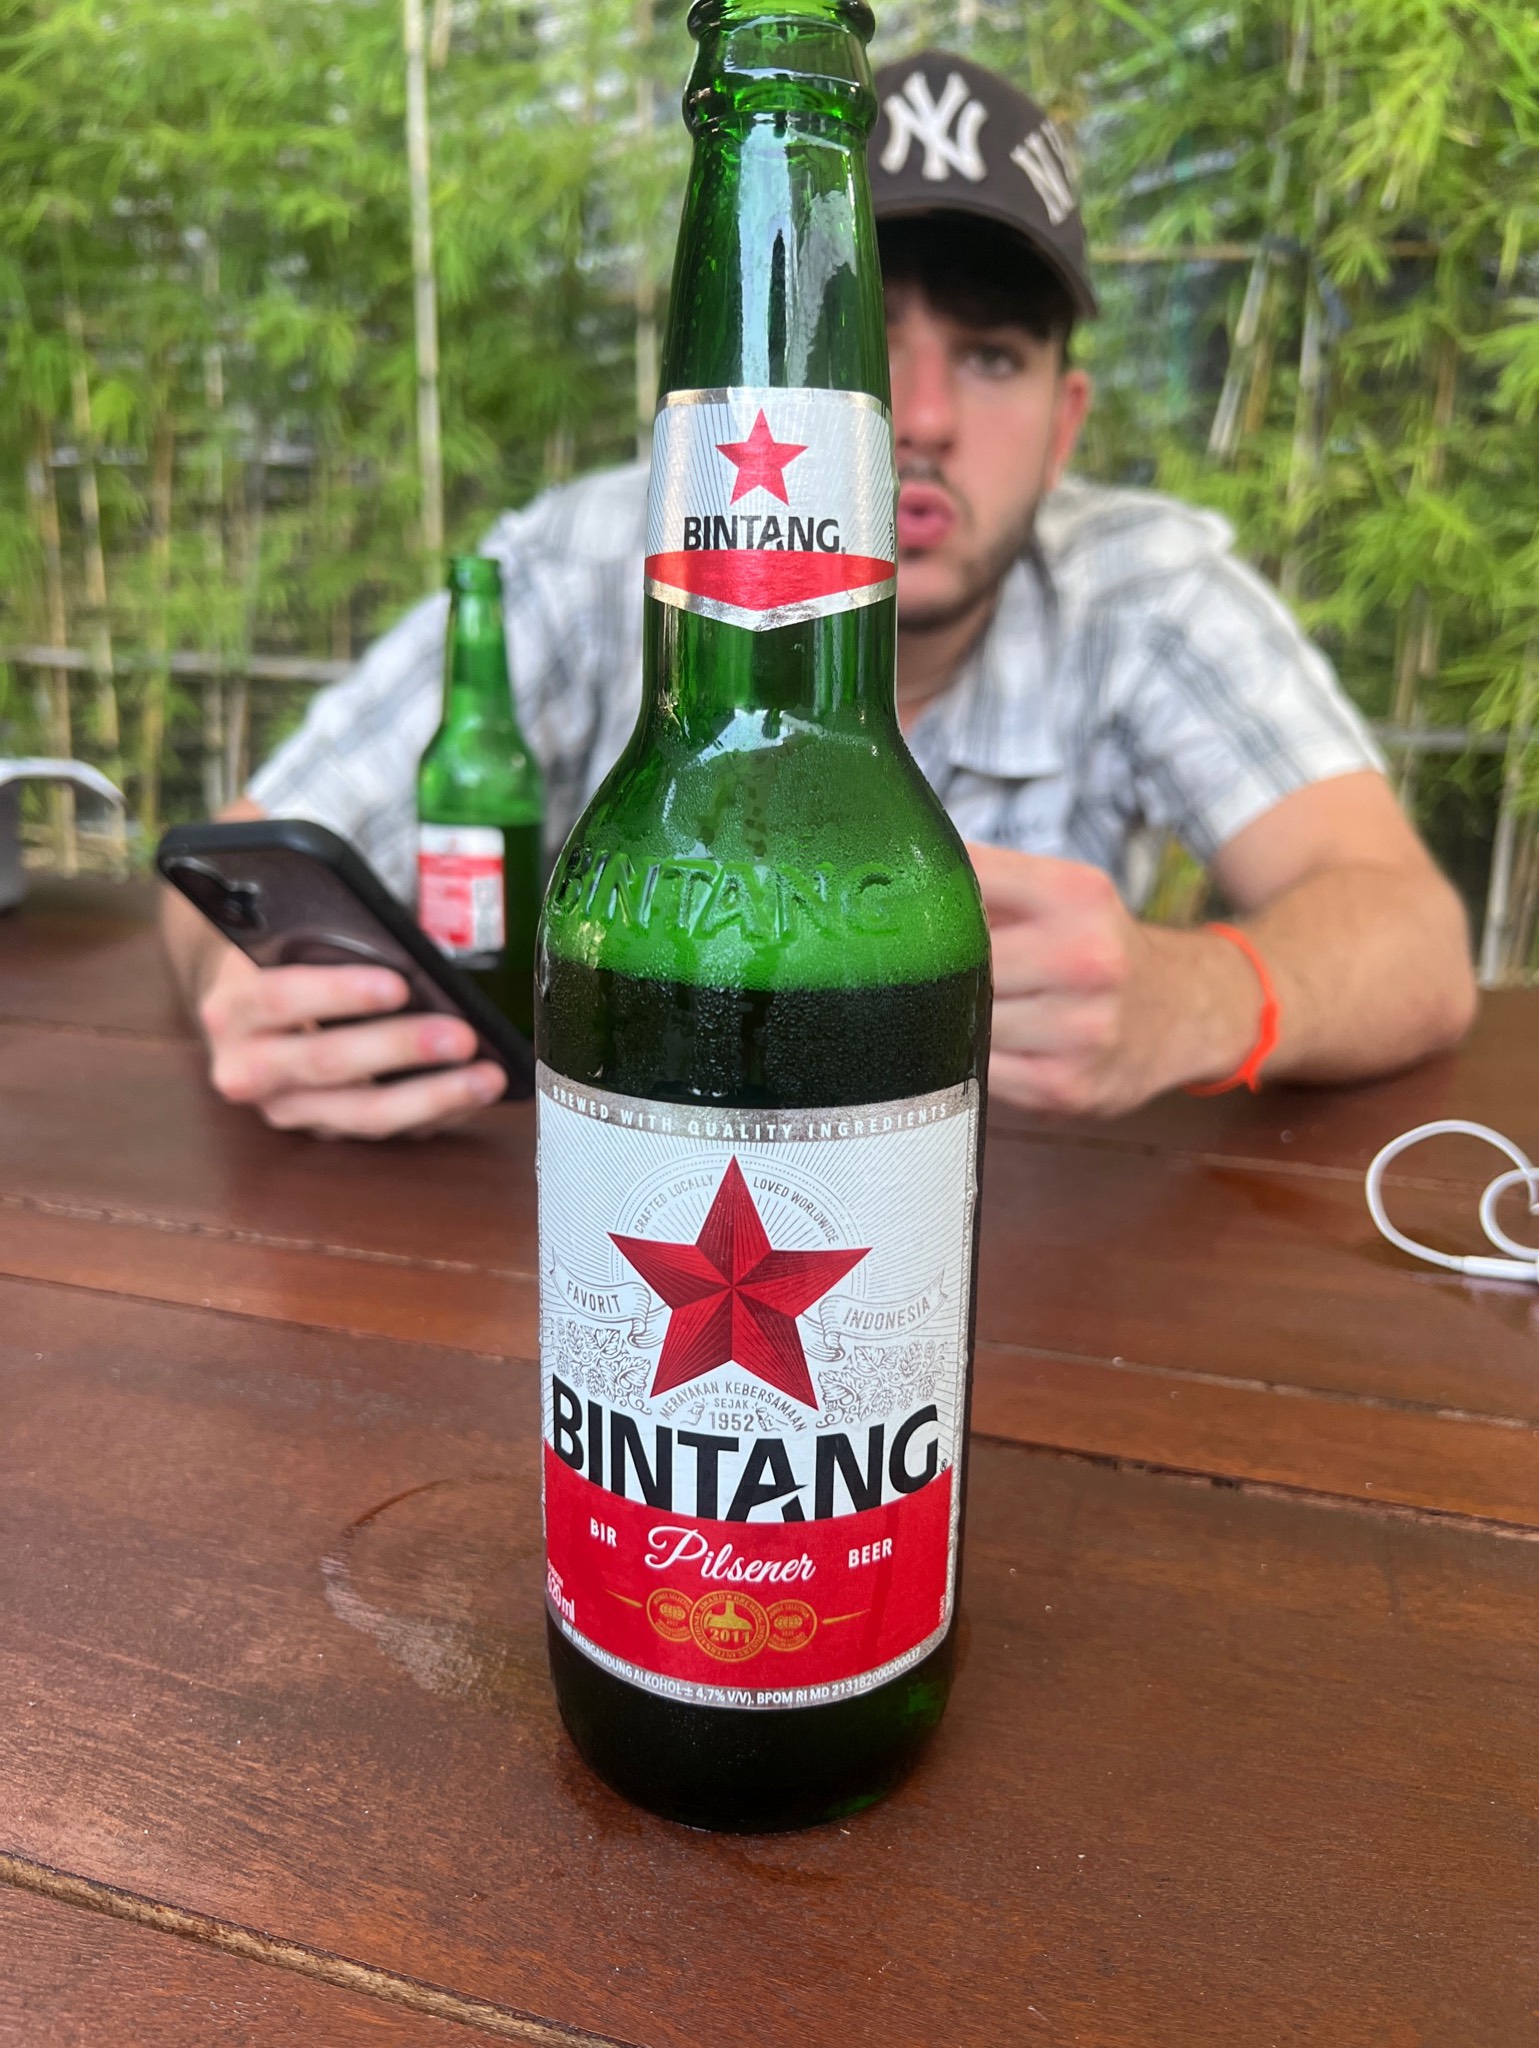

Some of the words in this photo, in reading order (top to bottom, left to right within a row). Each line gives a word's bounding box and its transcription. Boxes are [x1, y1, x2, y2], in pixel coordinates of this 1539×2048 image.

[879, 70, 988, 182] NY
[684, 515, 840, 553] BINTANG
[552, 1085, 609, 1121] BREWED
[620, 1109, 673, 1132] WITH
[688, 1119, 792, 1140] QUALITY
[808, 1103, 948, 1138] INGREDIENTS
[634, 1194, 669, 1235] CRAFTED
[669, 1174, 714, 1199] LOCALLY
[753, 1178, 789, 1199] LOVED
[790, 1191, 840, 1245] WORLDWIDE
[566, 1280, 620, 1313] FAVORIT
[842, 1297, 931, 1331] INDONESIA
[659, 1381, 720, 1421] MERAYAKAN
[725, 1381, 809, 1433] KEBERSAMAAN
[708, 1411, 755, 1433] 1952
[713, 1397, 750, 1410] SEJAK
[552, 1373, 940, 1522] BINTANG
[589, 1518, 618, 1548] BIR
[645, 1525, 817, 1583] Pilsener
[848, 1538, 893, 1568] BEER
[709, 1628, 751, 1644] 2011
[572, 1630, 633, 1678] (MENGANDUNG
[695, 1689, 726, 1703] 4,7%
[727, 1691, 755, 1706] V/V).
[757, 1692, 793, 1704] BPOM
[796, 1691, 808, 1702] RI
[810, 1686, 830, 1701] MD
